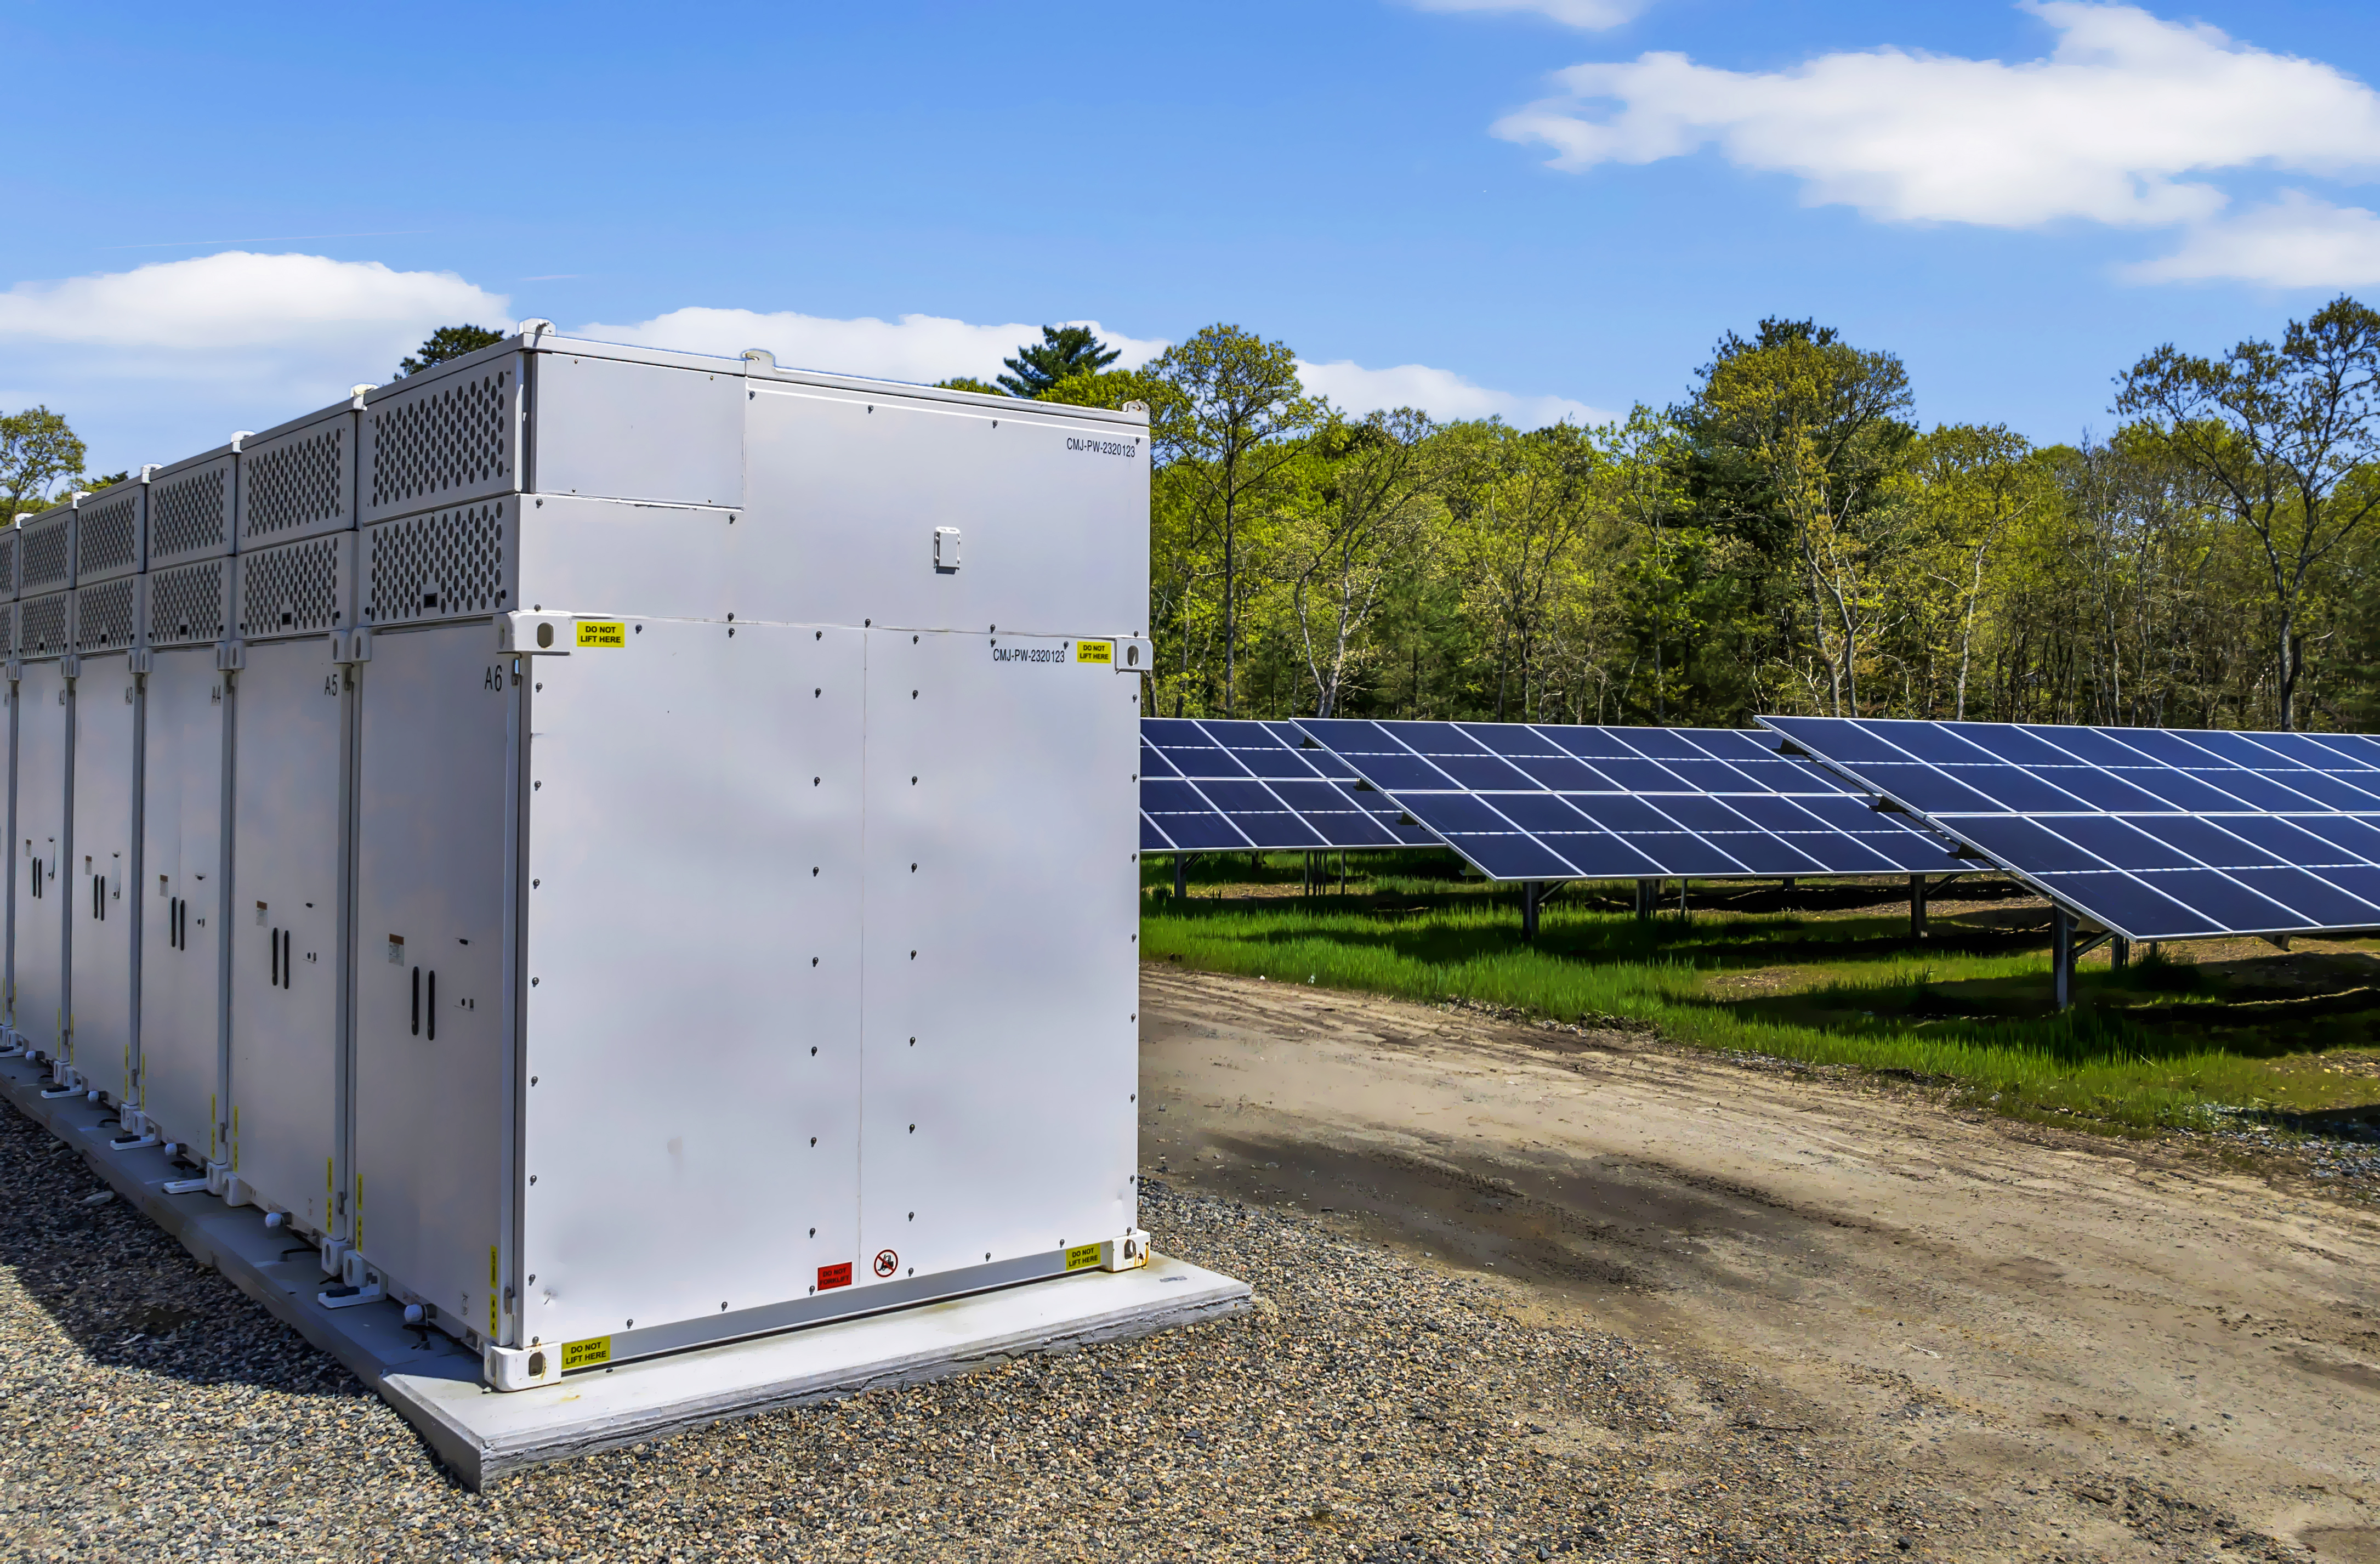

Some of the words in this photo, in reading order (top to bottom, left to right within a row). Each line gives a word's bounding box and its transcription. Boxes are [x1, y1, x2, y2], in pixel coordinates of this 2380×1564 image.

[1067, 438, 1135, 457] CMJ-PW-2320123
[993, 649, 1065, 662] CMJ-PW-2320123
[325, 674, 338, 696] A5
[485, 665, 502, 692] A6
[212, 685, 221, 704] A4
[1082, 1255, 1098, 1263] HERE
[820, 1275, 849, 1286] FORKLIFT
[585, 1342, 602, 1351] NOT
[566, 1355, 583, 1364] LIFT
[585, 1351, 606, 1361] HERE
